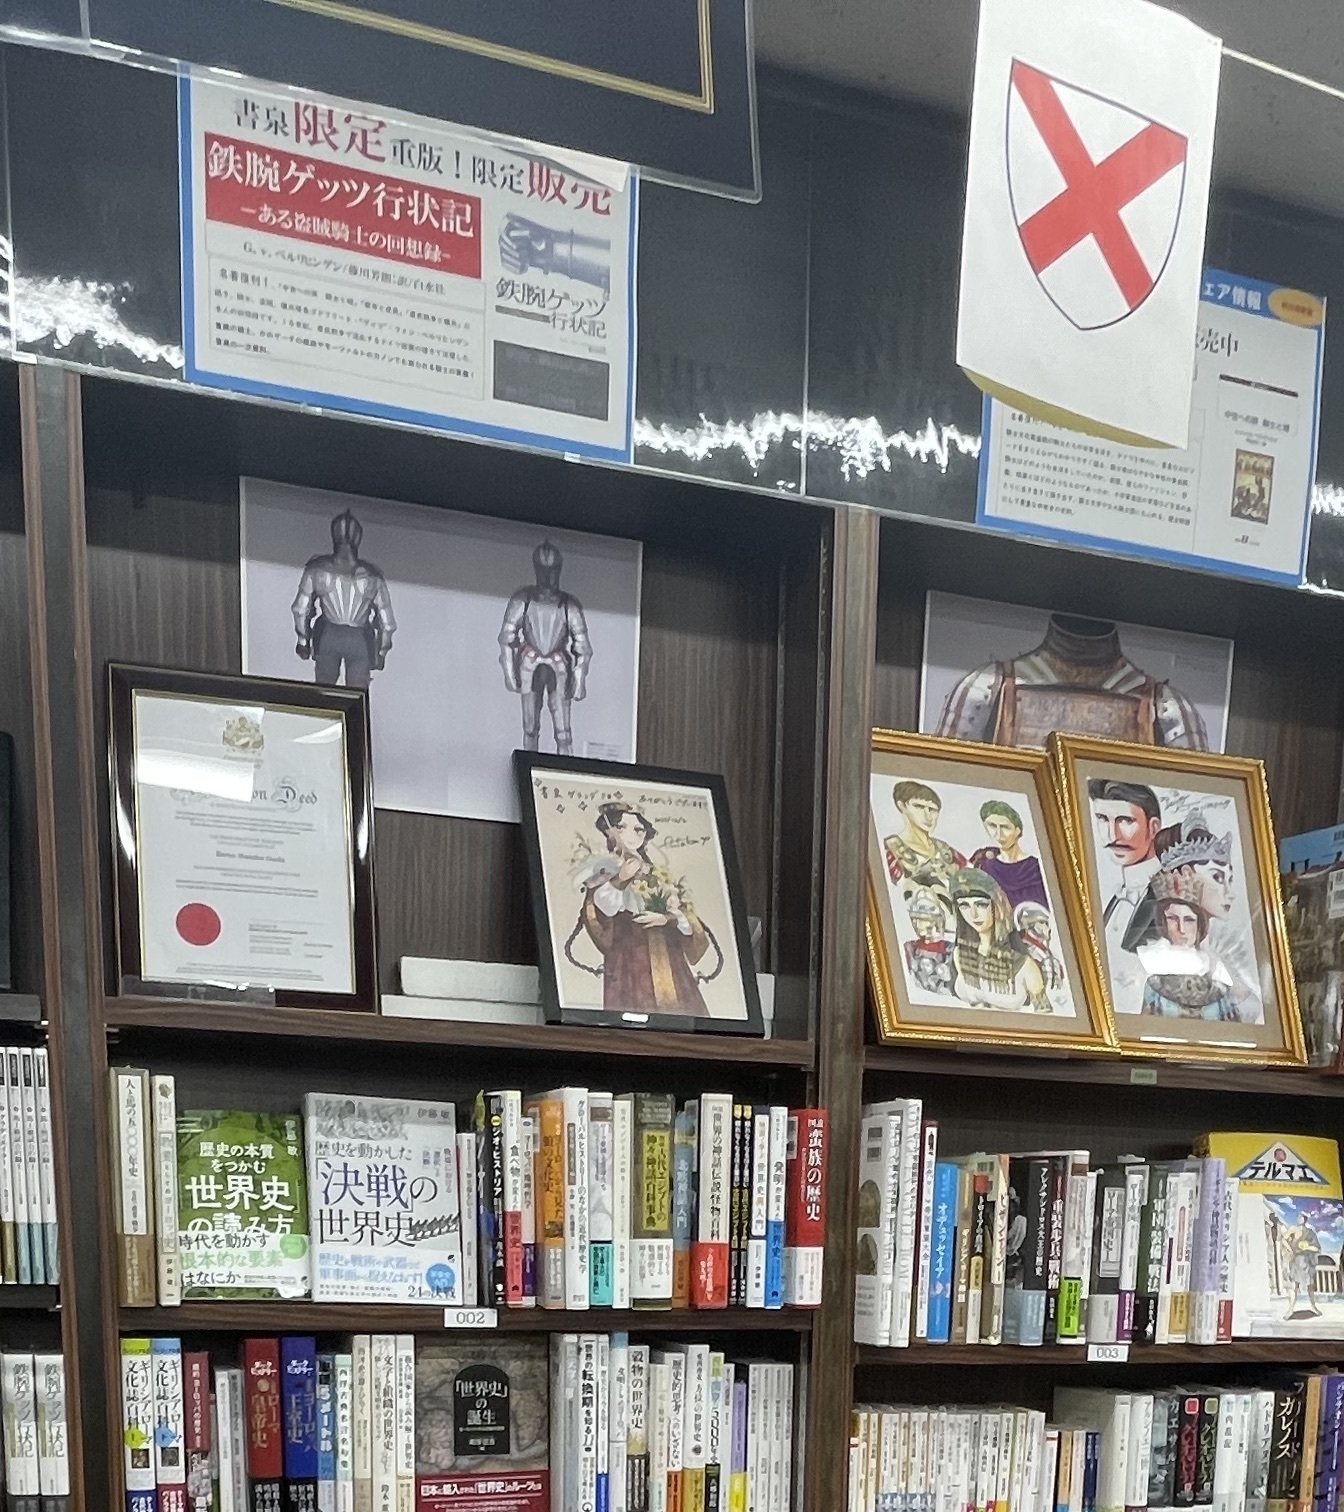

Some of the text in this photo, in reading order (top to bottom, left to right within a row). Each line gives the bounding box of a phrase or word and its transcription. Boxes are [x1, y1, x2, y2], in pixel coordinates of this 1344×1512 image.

[206, 141, 475, 238] 鉄腕ゲッツ行状記
[496, 277, 607, 316] 鉄腕ゲッツ
[548, 312, 608, 339] 行状記
[199, 1141, 275, 1159] 歴史の本質
[314, 1141, 413, 1161] 歴史を動かした
[211, 1160, 267, 1173] をつかむ
[806, 1130, 824, 1222] 蛮族の歴史
[1249, 1160, 1311, 1184] テルマエ
[314, 1158, 438, 1212] 「決戦」の
[188, 1212, 294, 1235] の読み方
[314, 1210, 415, 1248] 世界史
[178, 1232, 270, 1250] 時代を動かす
[179, 1271, 242, 1286] はなにか
[456, 1311, 485, 1325] 002
[1097, 1347, 1119, 1358] 003
[456, 1380, 509, 1399] 「世界史」
[631, 1350, 644, 1429] 穀物の世界史
[476, 1399, 488, 1408] の
[466, 1409, 496, 1425] 誕生
[1277, 1397, 1297, 1460] ガレノス
